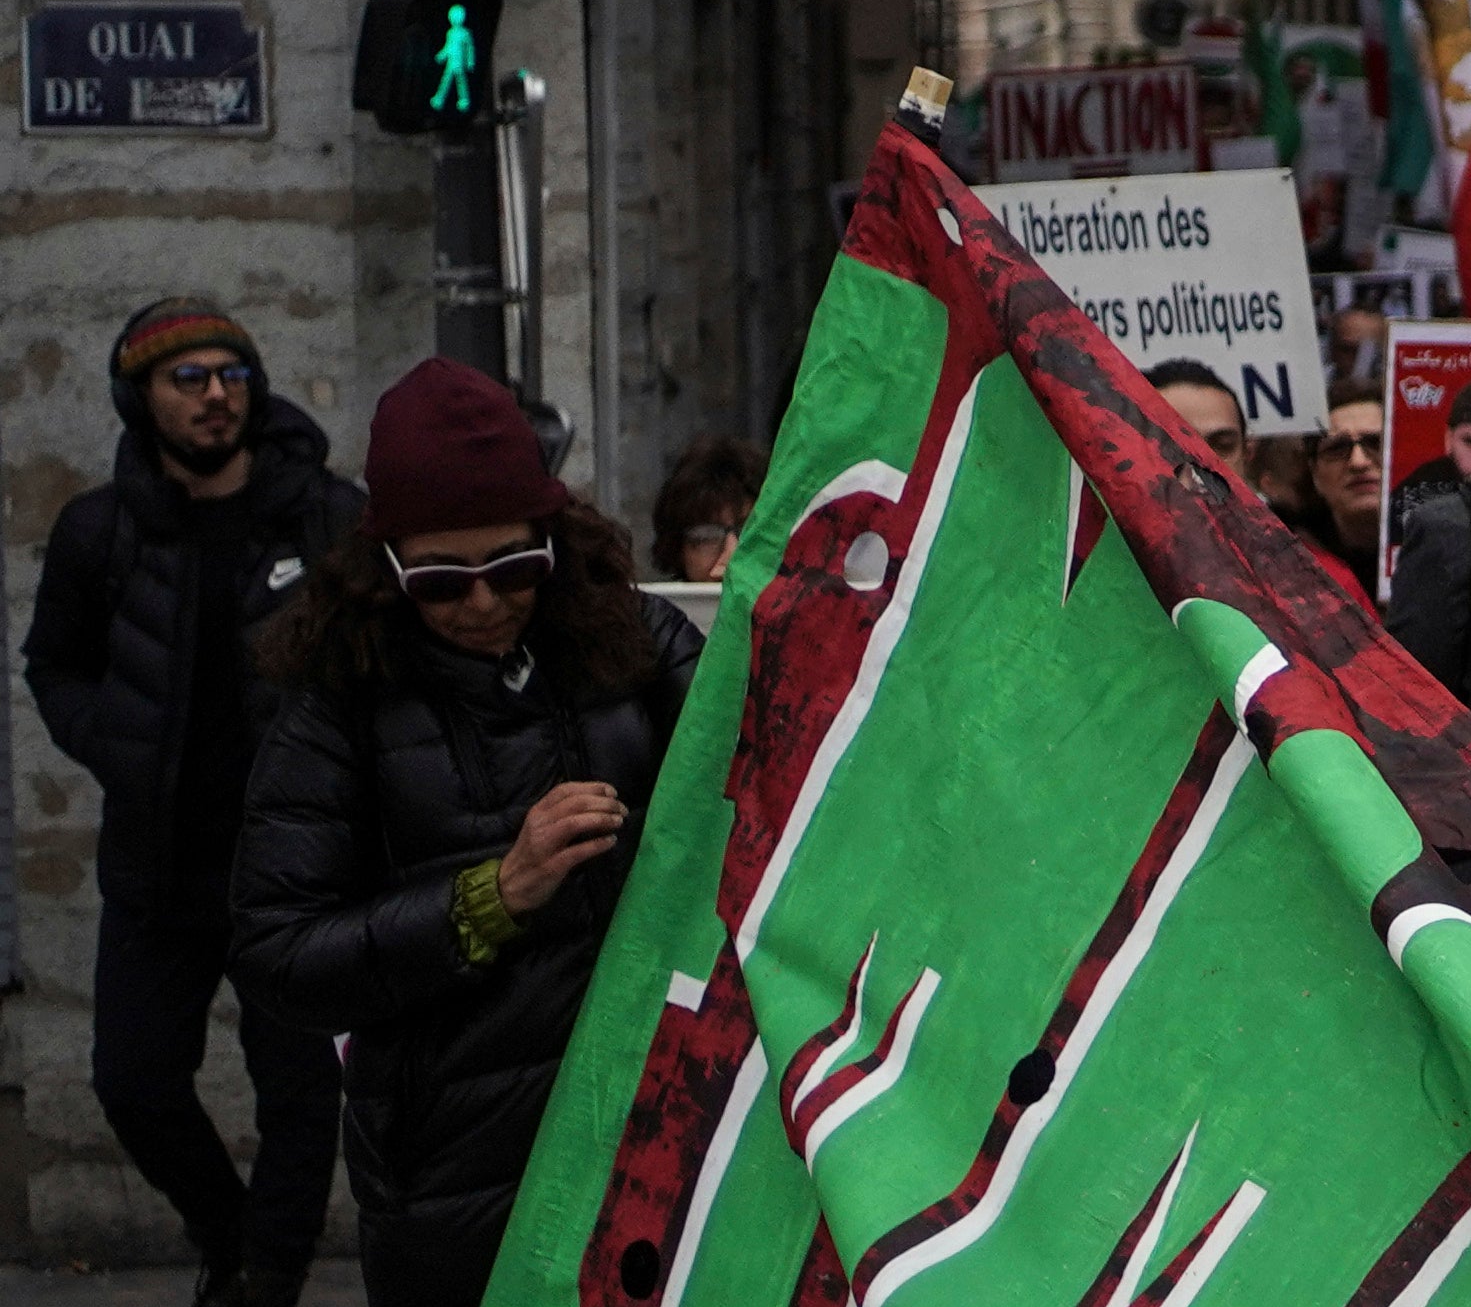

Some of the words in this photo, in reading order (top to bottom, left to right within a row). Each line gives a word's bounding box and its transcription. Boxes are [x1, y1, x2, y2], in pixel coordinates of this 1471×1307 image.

[88, 21, 195, 66] QUAI
[44, 76, 103, 117] DE
[1156, 194, 1210, 250] des
[1137, 279, 1284, 352] politiques
